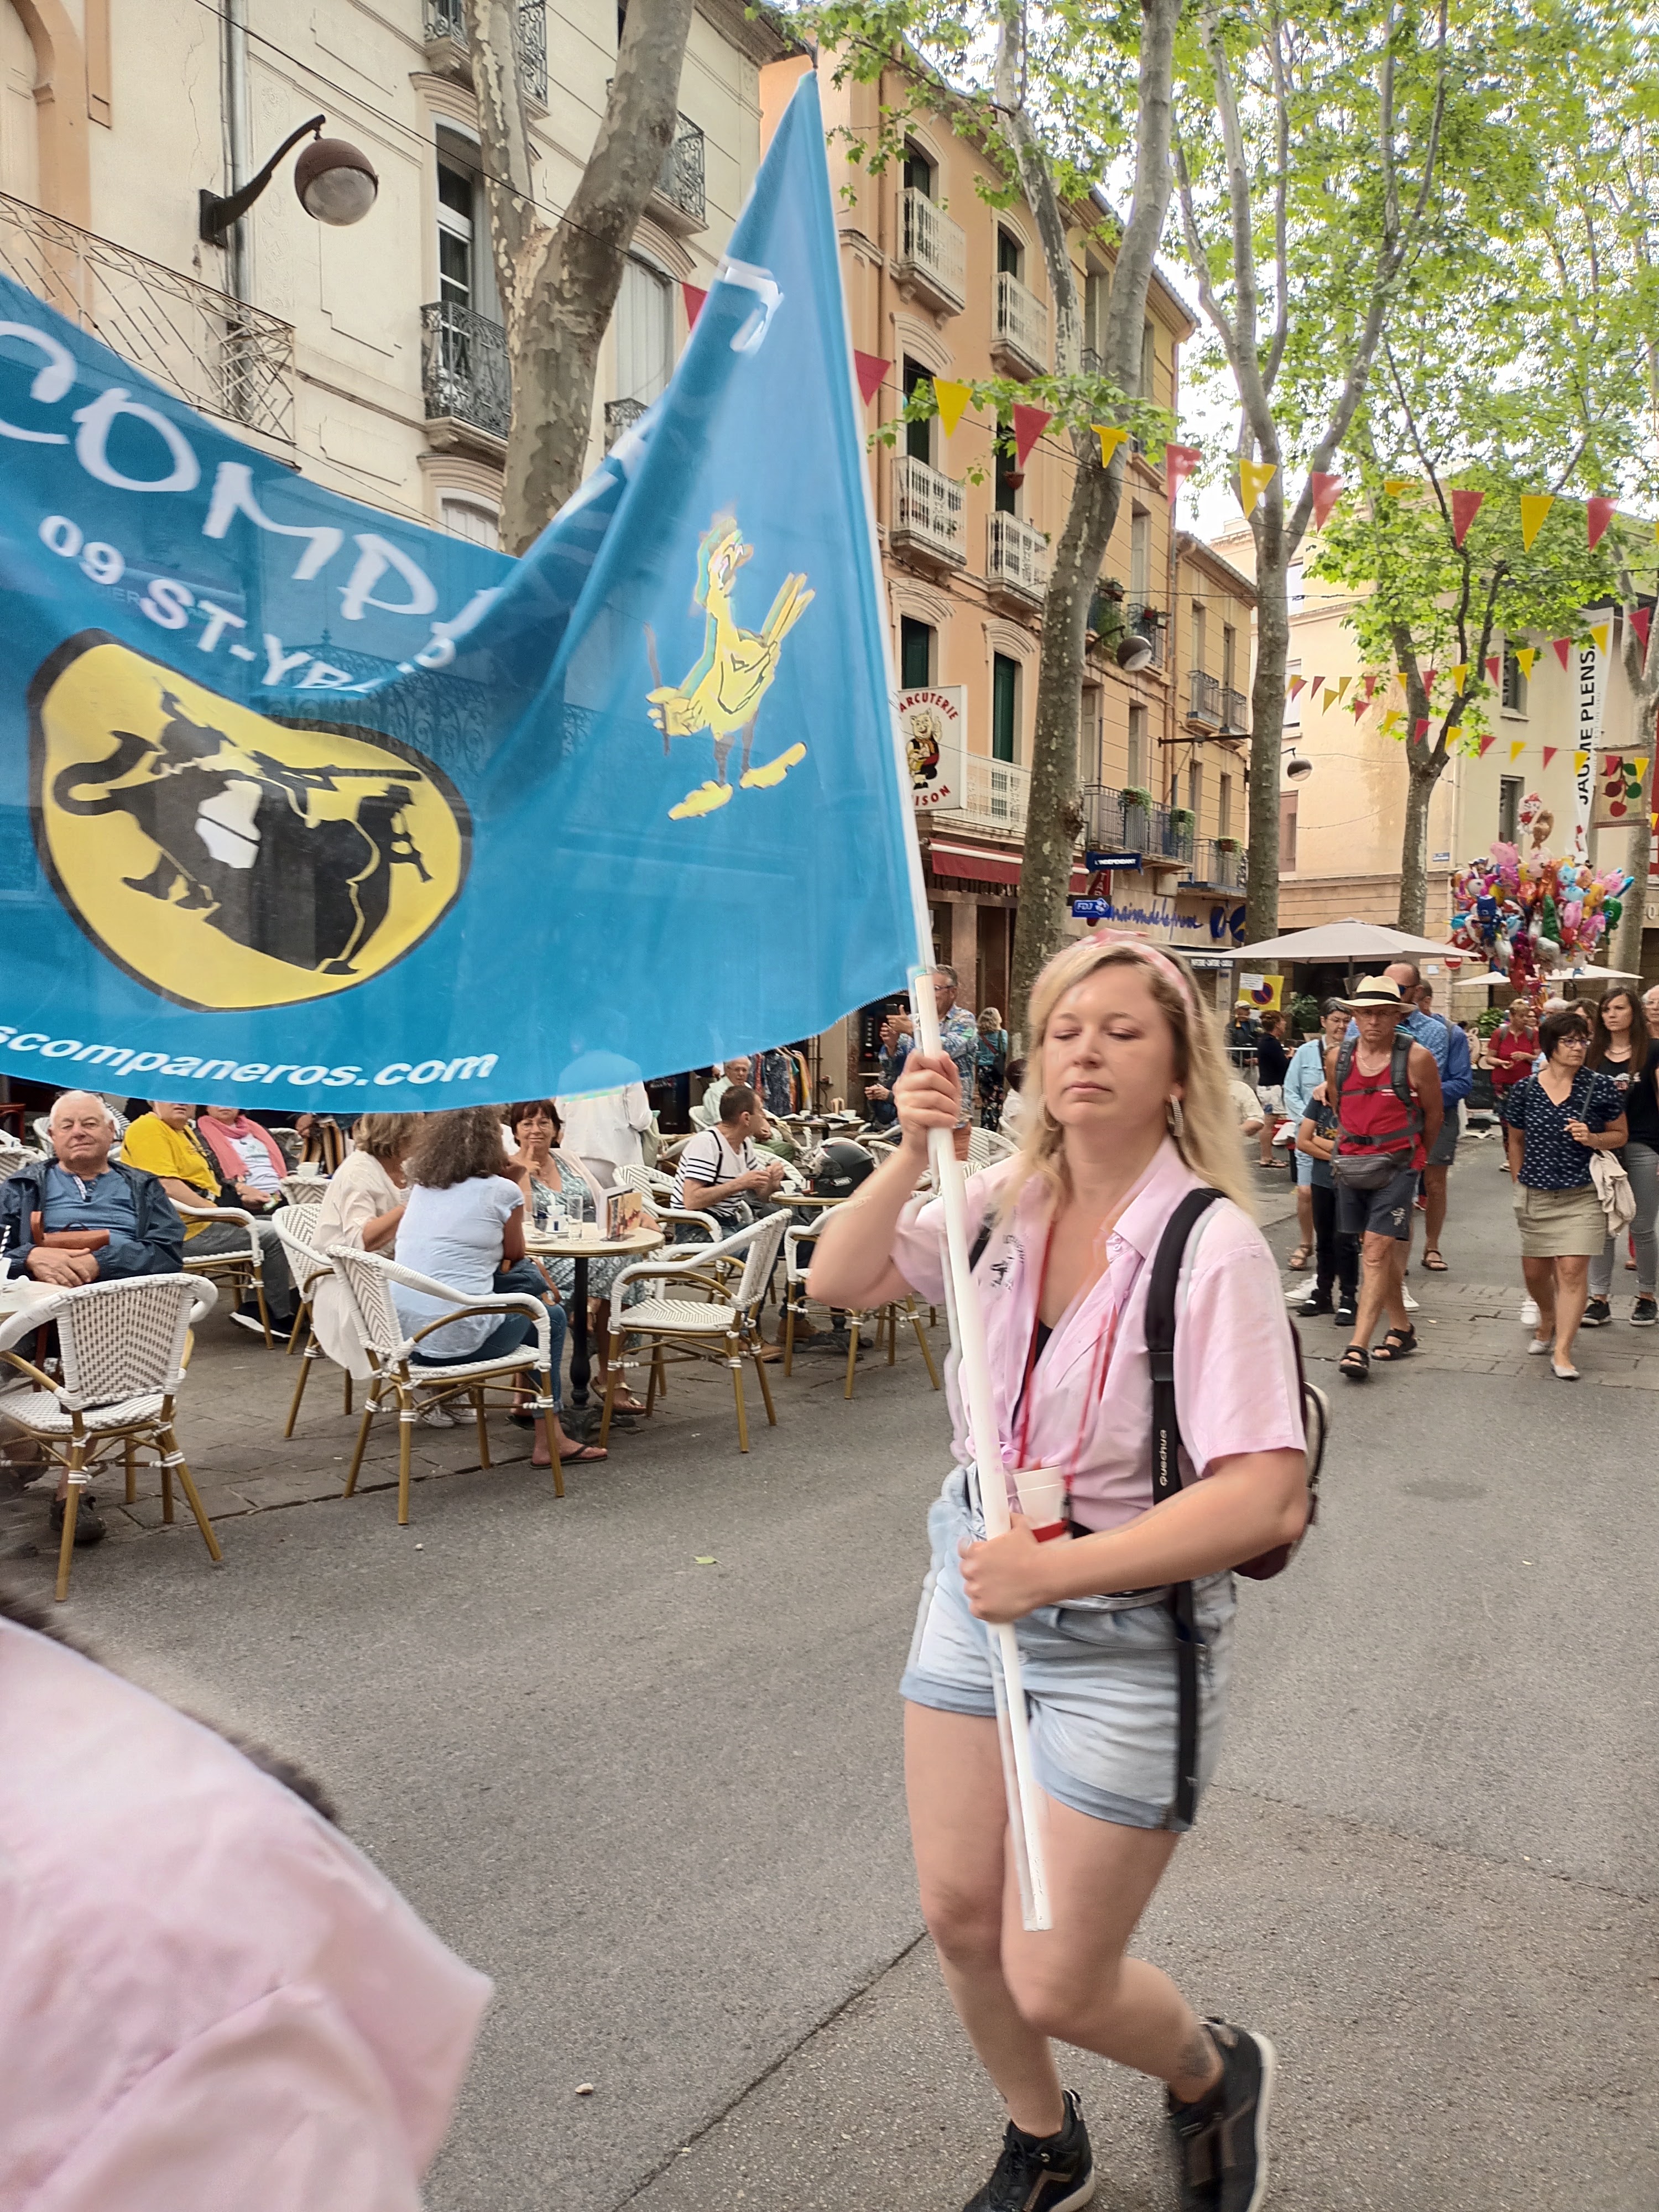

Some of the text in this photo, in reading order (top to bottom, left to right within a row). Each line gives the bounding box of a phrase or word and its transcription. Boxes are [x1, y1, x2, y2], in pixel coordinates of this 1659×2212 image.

[39, 515, 126, 585] 09
[899, 692, 959, 720] ARCUTERIE
[1580, 645, 1596, 722] PLENS
[915, 785, 951, 806] ISON
